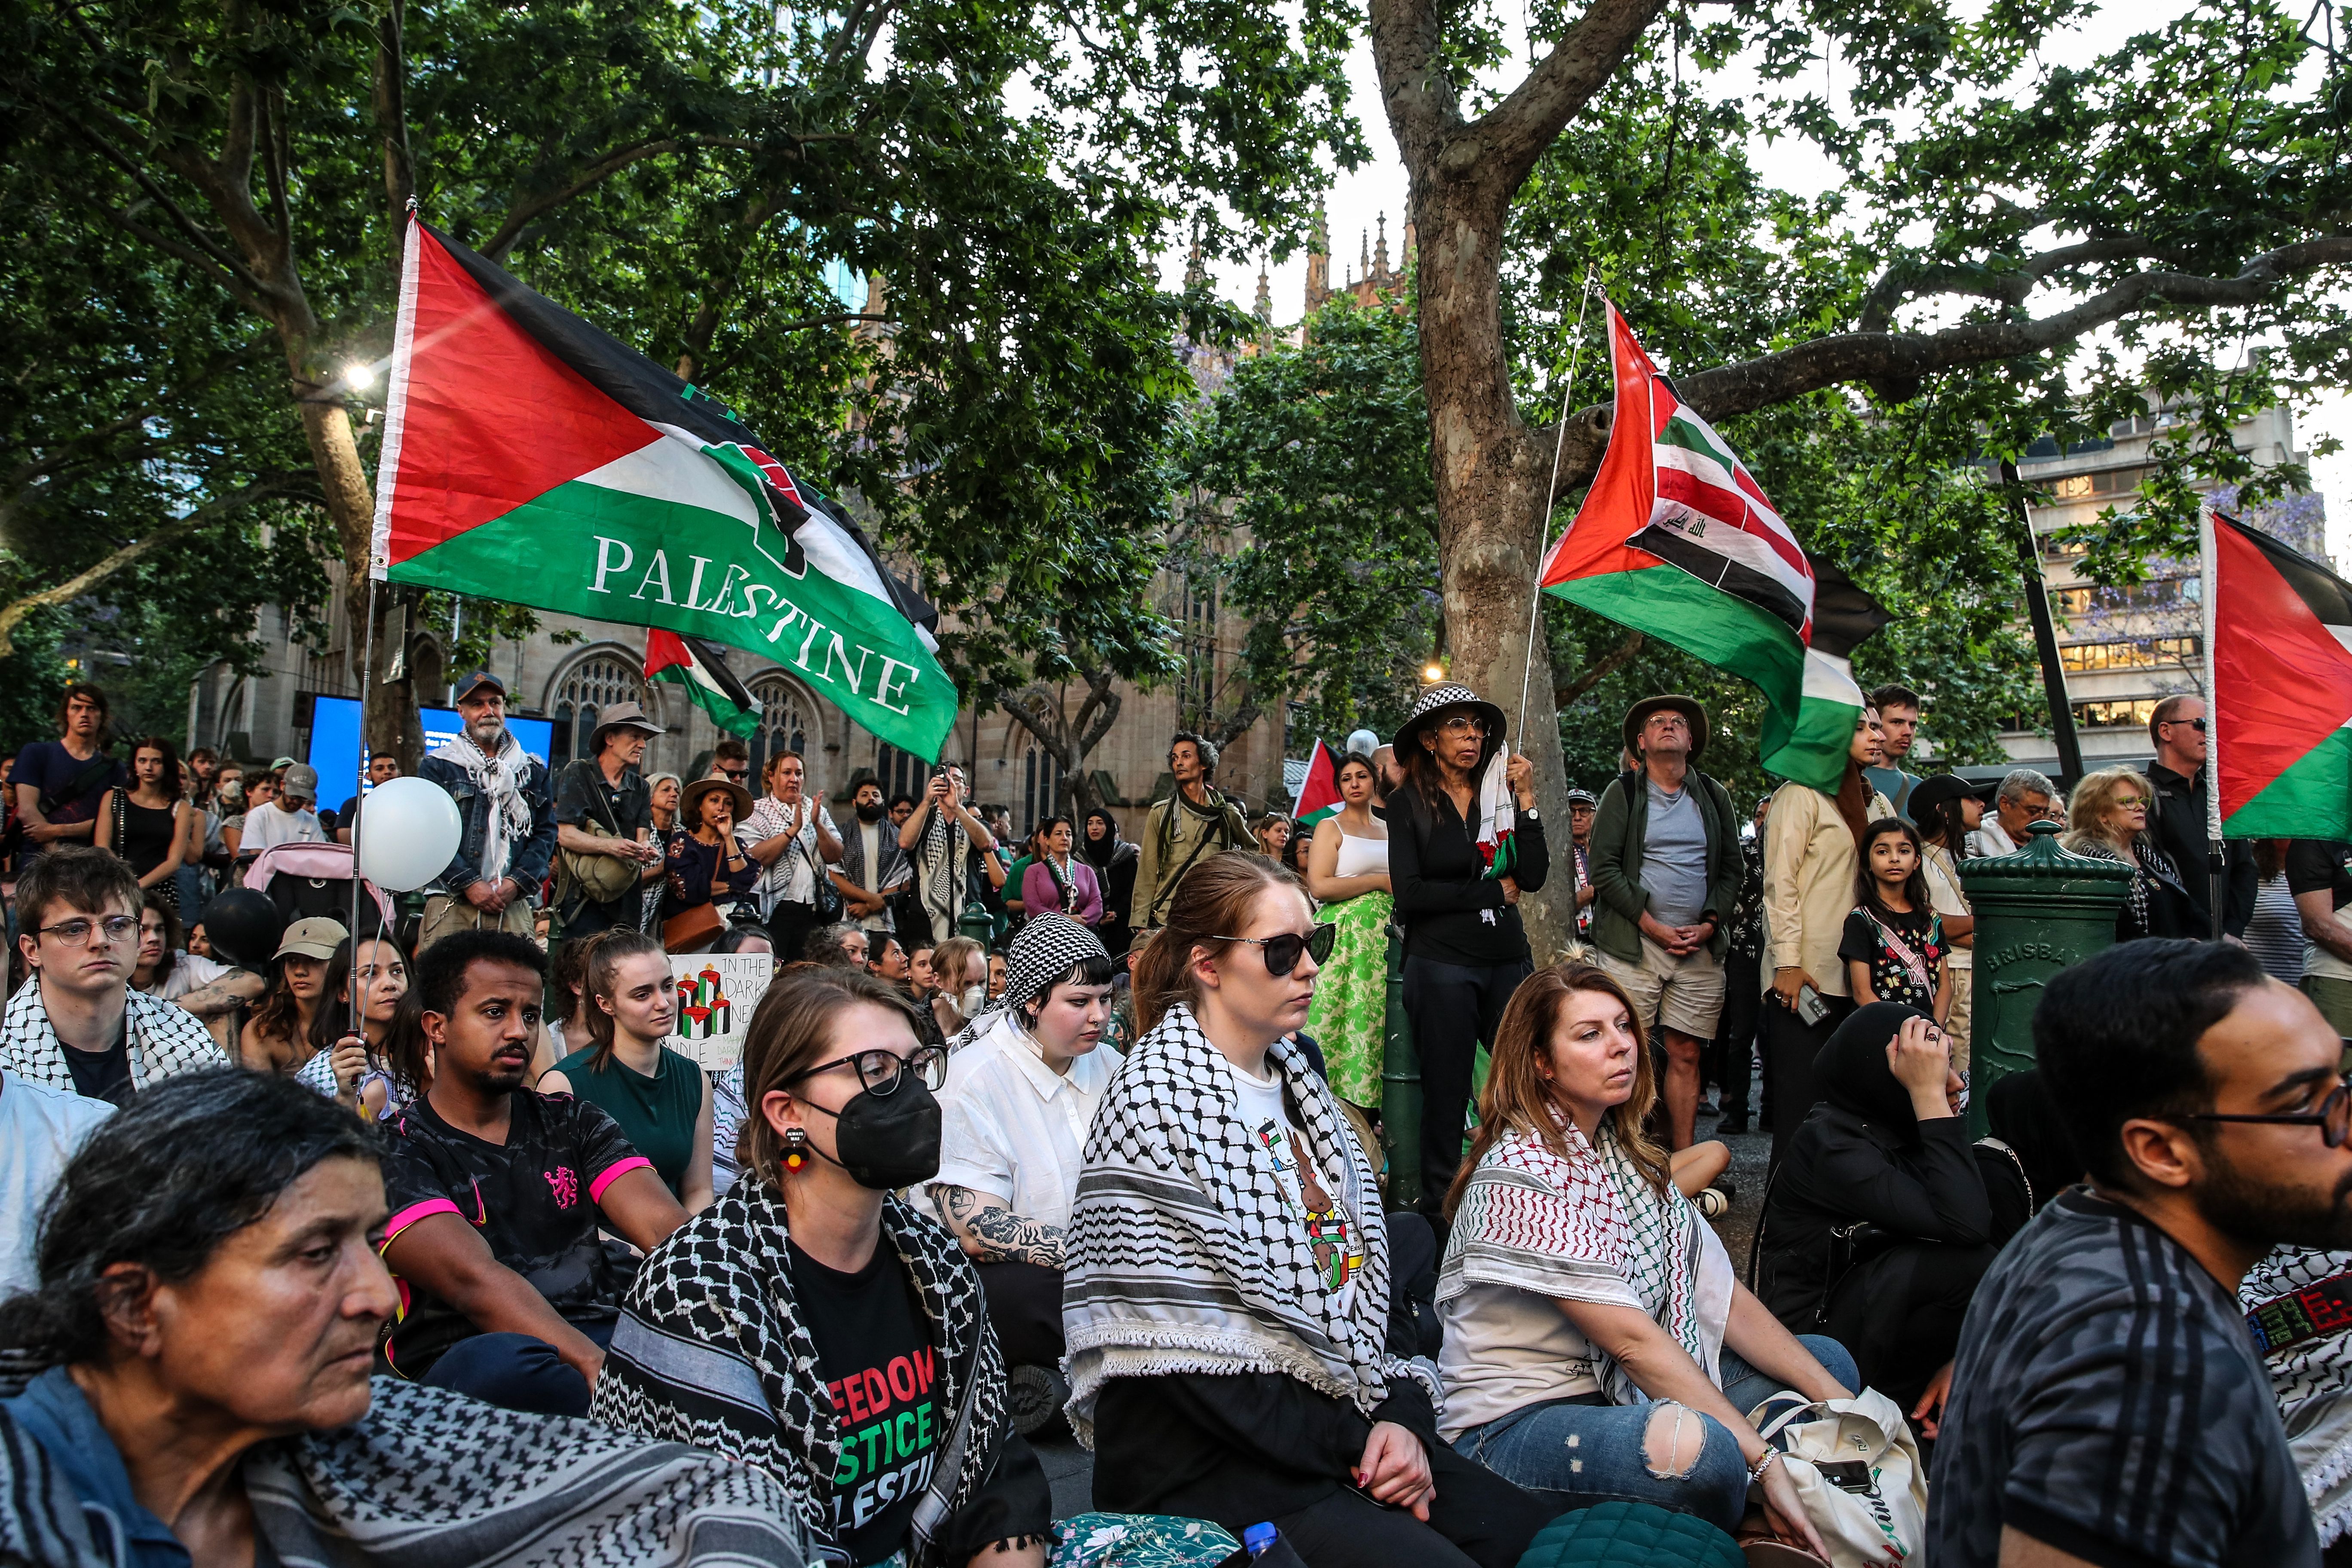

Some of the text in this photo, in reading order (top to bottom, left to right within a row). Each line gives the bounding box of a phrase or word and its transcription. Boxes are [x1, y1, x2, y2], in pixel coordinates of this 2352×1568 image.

[587, 536, 920, 717] PALESTINE
[722, 958, 766, 977] IN THE
[1984, 943, 2084, 974] BRISBA
[725, 978, 765, 1000] DARK
[833, 1401, 931, 1485] STICE
